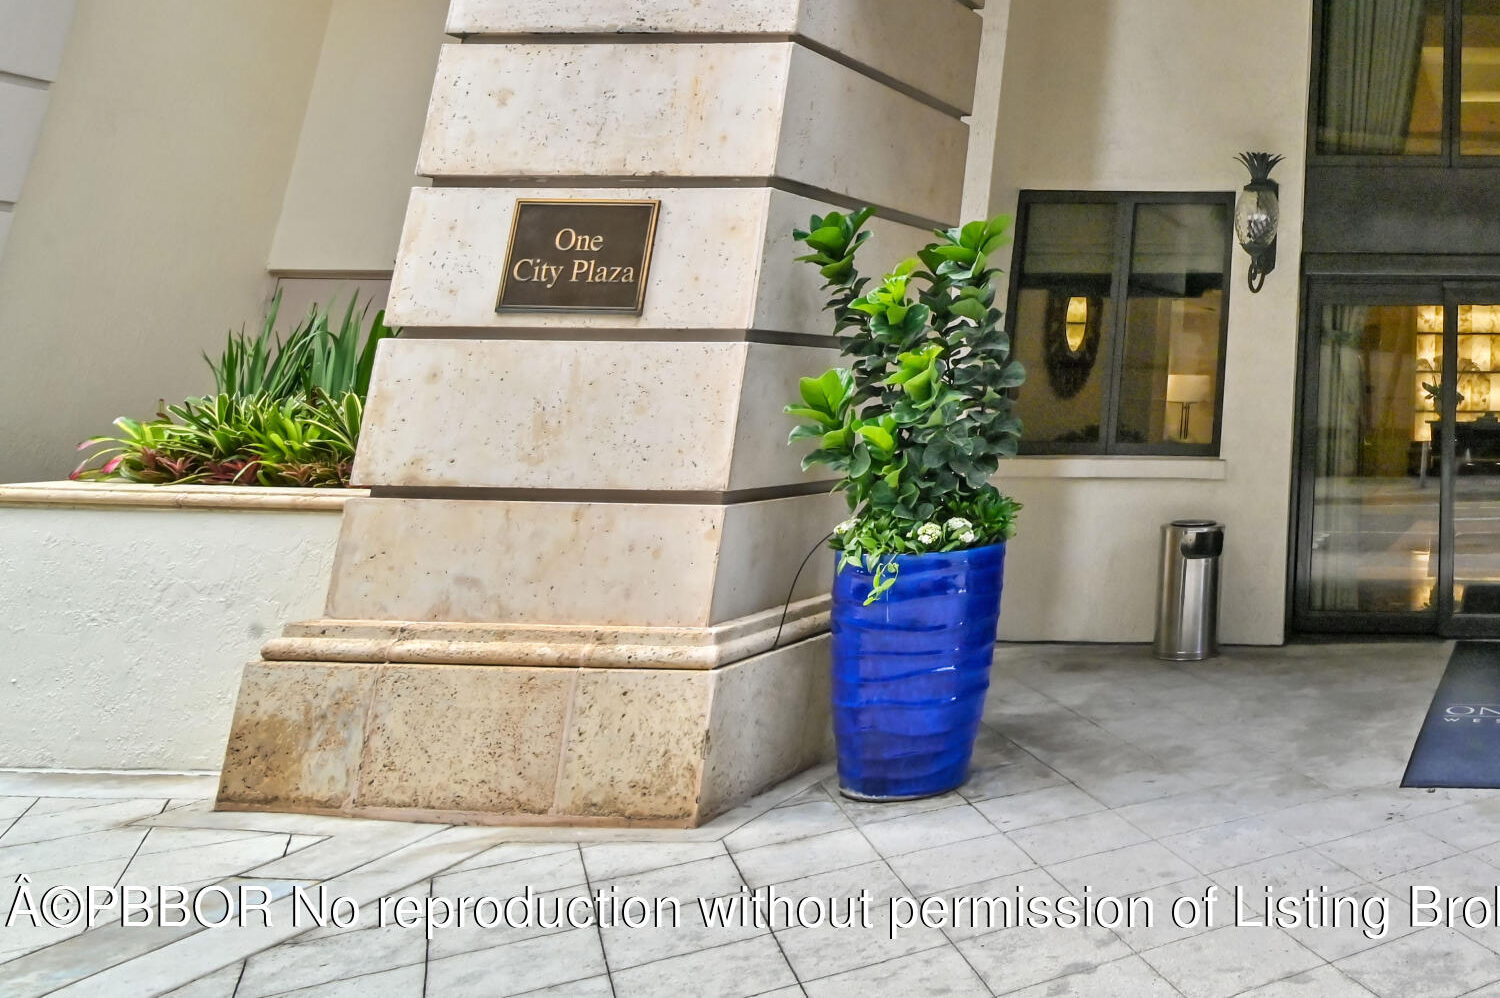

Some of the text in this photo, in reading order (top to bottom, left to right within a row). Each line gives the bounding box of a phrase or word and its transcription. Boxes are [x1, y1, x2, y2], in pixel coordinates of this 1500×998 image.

[555, 228, 604, 251] One
[513, 259, 635, 288] City Plaza
